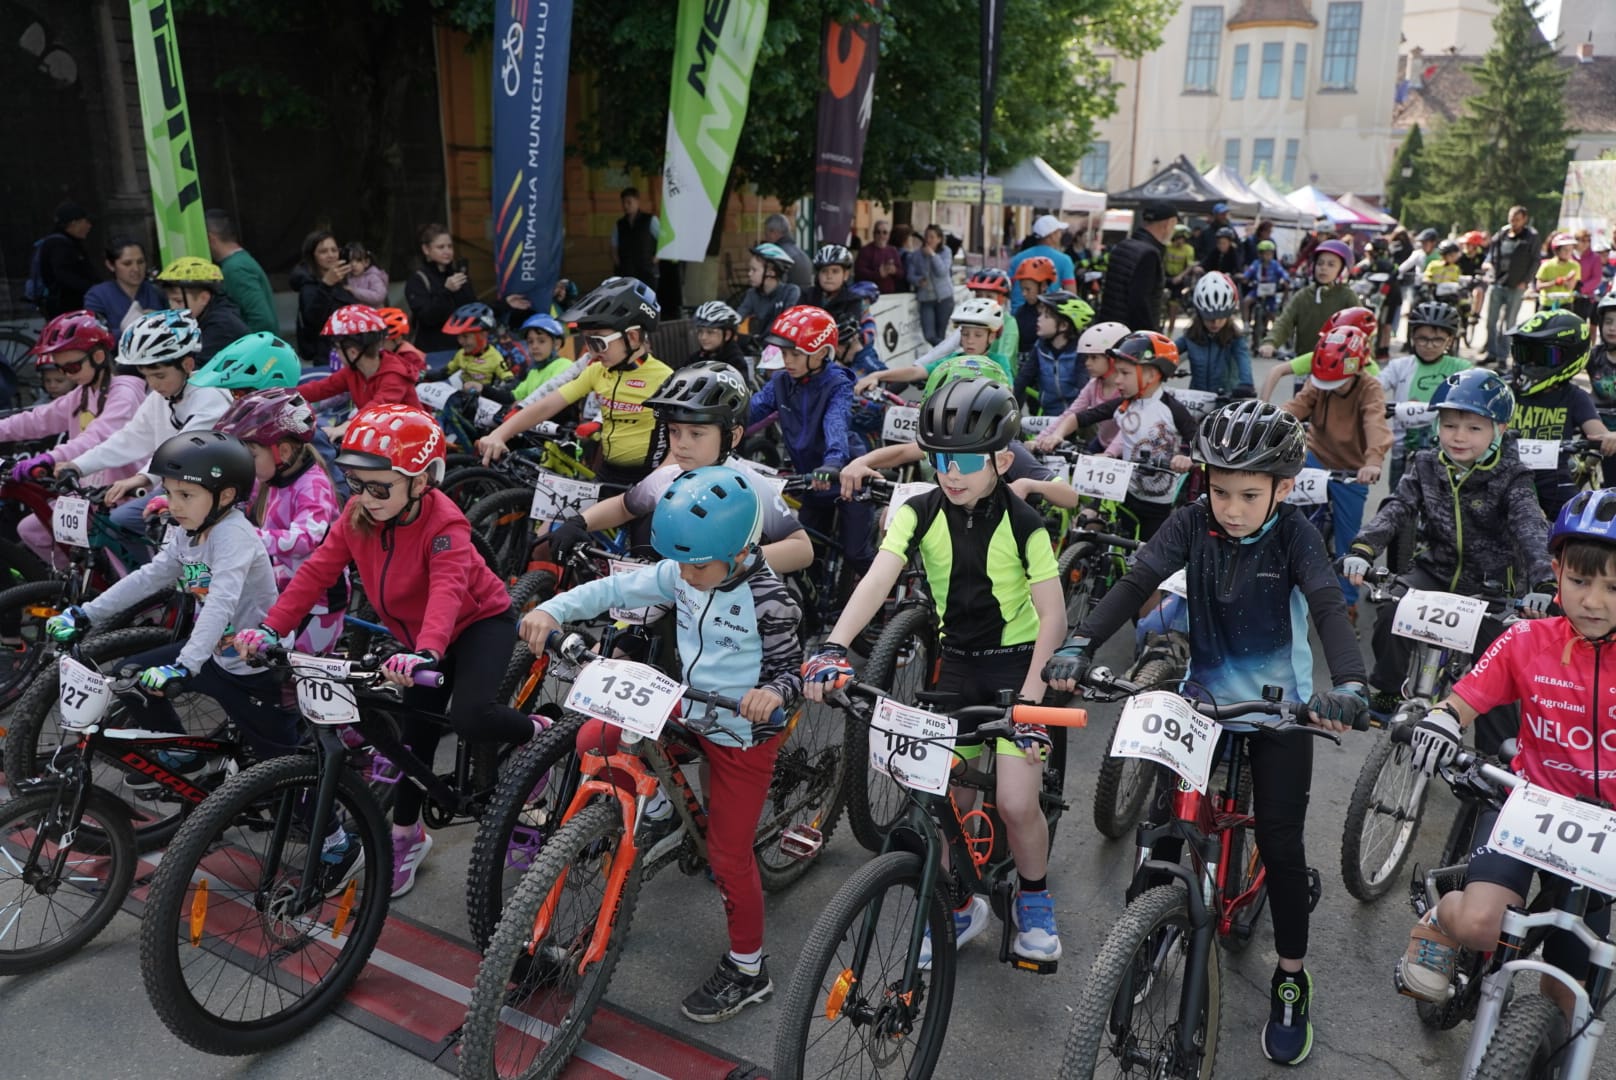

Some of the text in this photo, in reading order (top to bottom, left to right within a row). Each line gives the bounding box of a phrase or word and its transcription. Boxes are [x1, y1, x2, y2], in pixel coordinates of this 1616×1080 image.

[423, 385, 443, 398] 015
[893, 418, 919, 431] 025
[411, 423, 441, 464] woom
[1086, 469, 1116, 485] 119
[550, 493, 581, 510] 114
[60, 513, 79, 530] 109
[1416, 604, 1460, 628] 120
[326, 664, 342, 672] KIDS
[61, 682, 89, 710] 127
[303, 678, 333, 702] 110
[601, 675, 654, 707] 135
[649, 681, 673, 695] RACE
[1540, 697, 1586, 714] agroland
[925, 718, 946, 729] KIDS
[1191, 714, 1209, 731] KIDS
[1142, 713, 1194, 755] 094
[1189, 723, 1207, 741] RACE
[884, 731, 928, 762] 106
[121, 752, 210, 804] DRAG
[1534, 813, 1607, 855] 101
